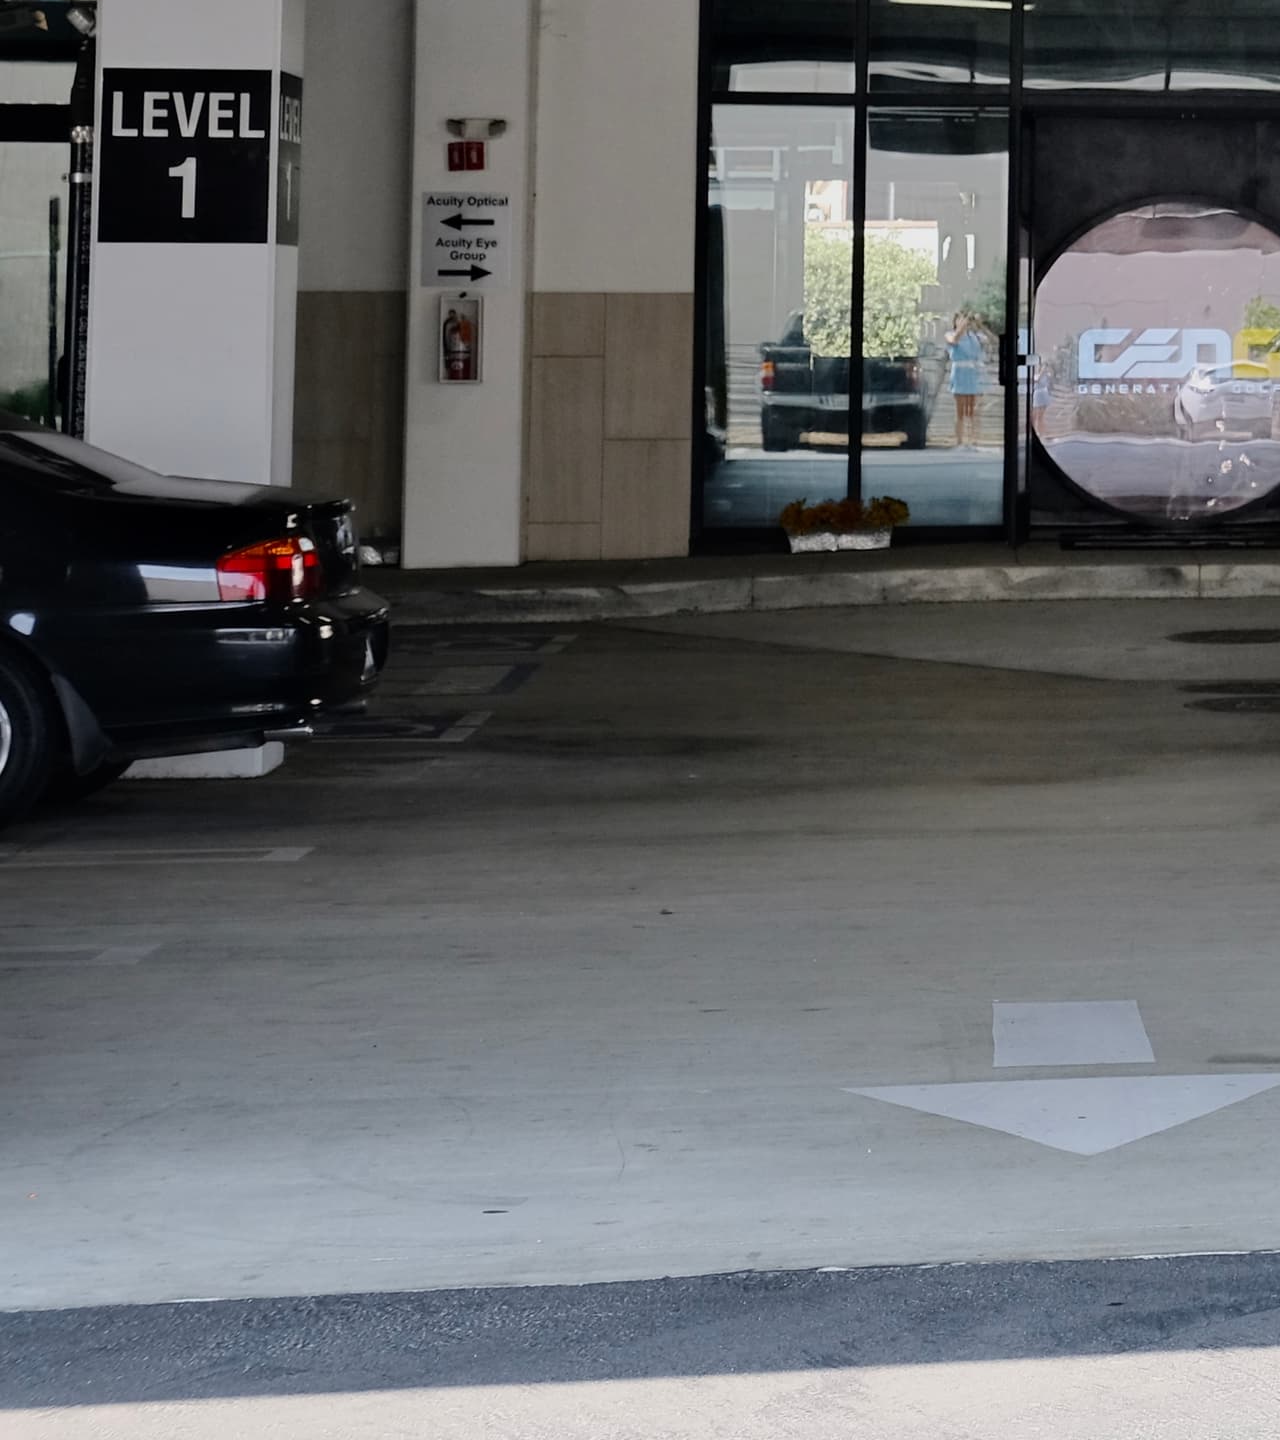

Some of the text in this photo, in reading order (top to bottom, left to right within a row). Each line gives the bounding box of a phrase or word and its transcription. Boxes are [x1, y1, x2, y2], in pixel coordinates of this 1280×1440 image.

[112, 91, 265, 139] LEVEL
[168, 157, 197, 219] 1
[427, 196, 508, 208] Acuity Optical
[435, 238, 498, 250] Acuity Eye
[449, 250, 487, 262] Group
